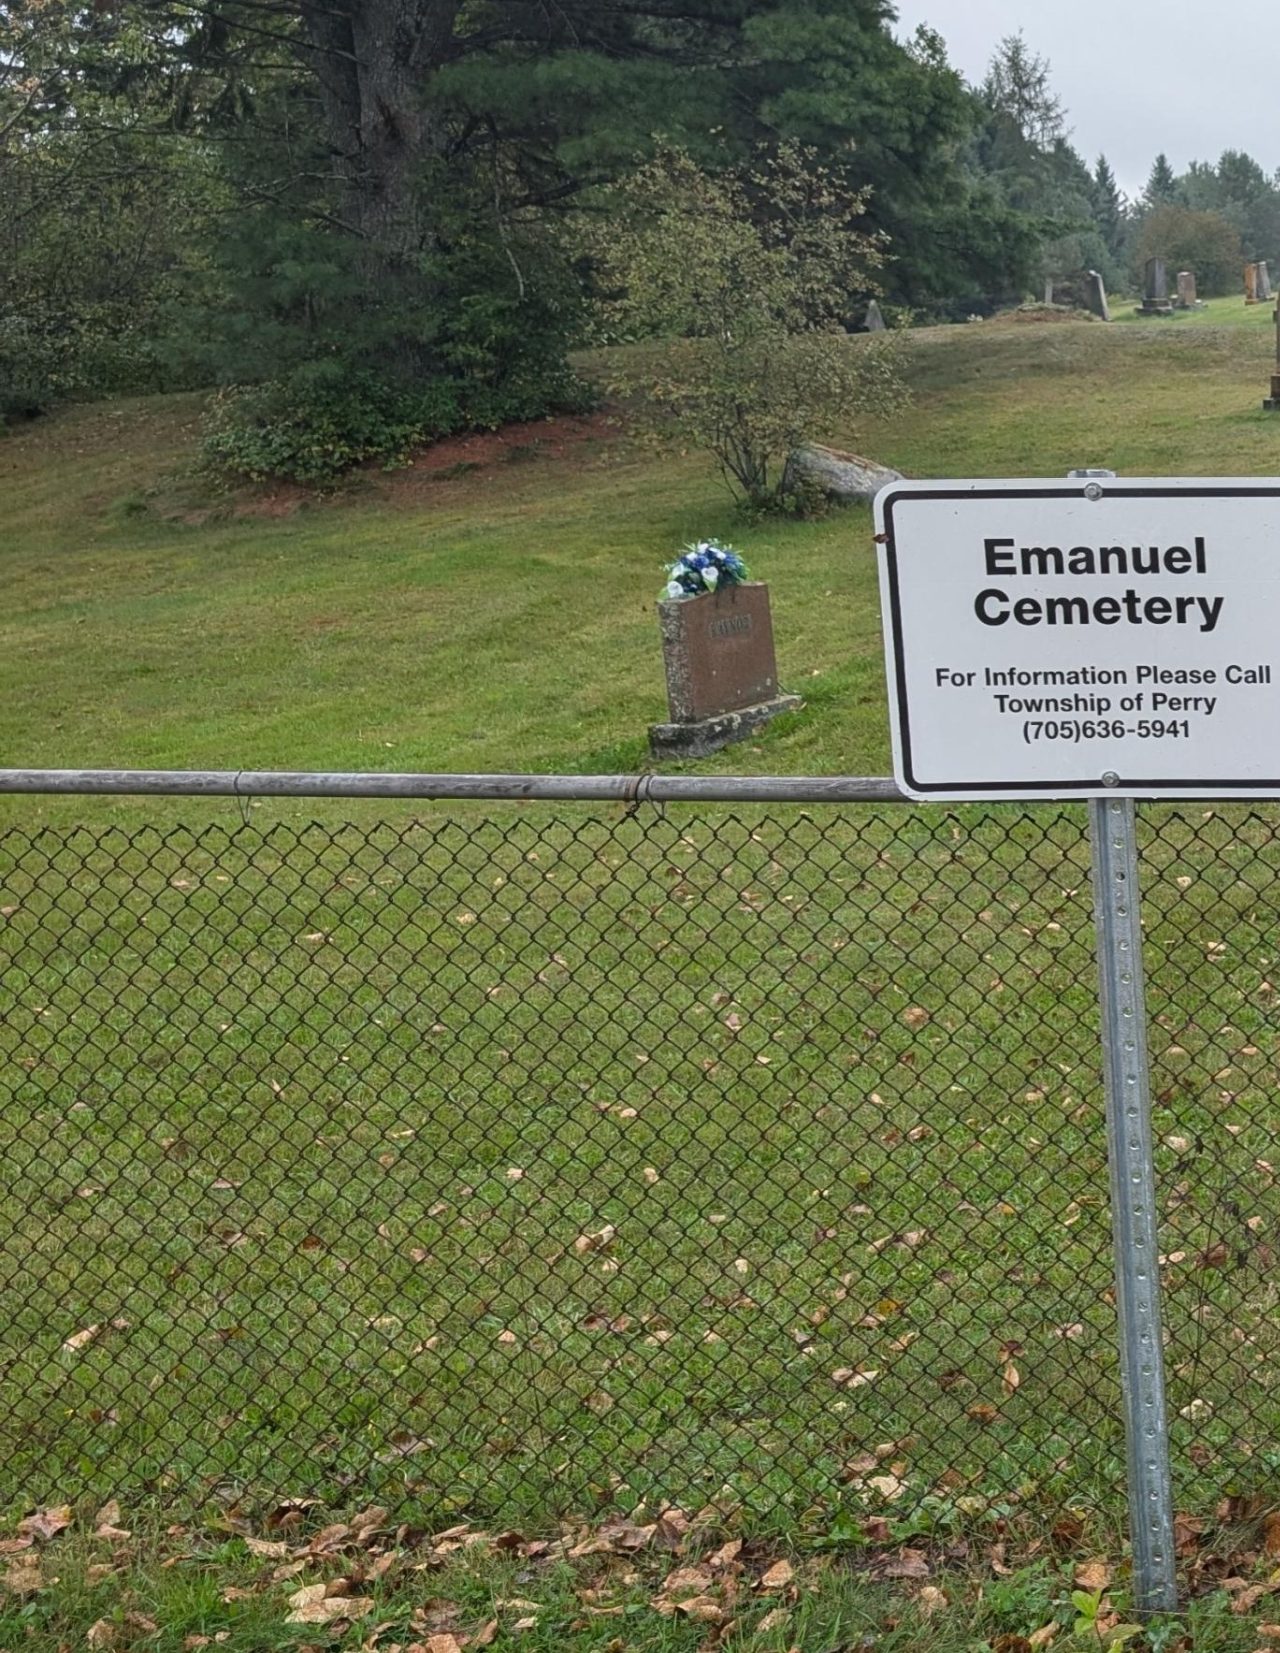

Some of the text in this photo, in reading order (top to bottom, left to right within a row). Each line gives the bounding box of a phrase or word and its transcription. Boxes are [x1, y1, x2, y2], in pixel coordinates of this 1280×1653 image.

[984, 537, 1207, 576] Emanuel
[974, 588, 1224, 633] Cemetery
[936, 664, 1271, 687] For Information Please Call
[994, 692, 1217, 716] Township of Perry
[1023, 719, 1190, 745] (705)636-5941
